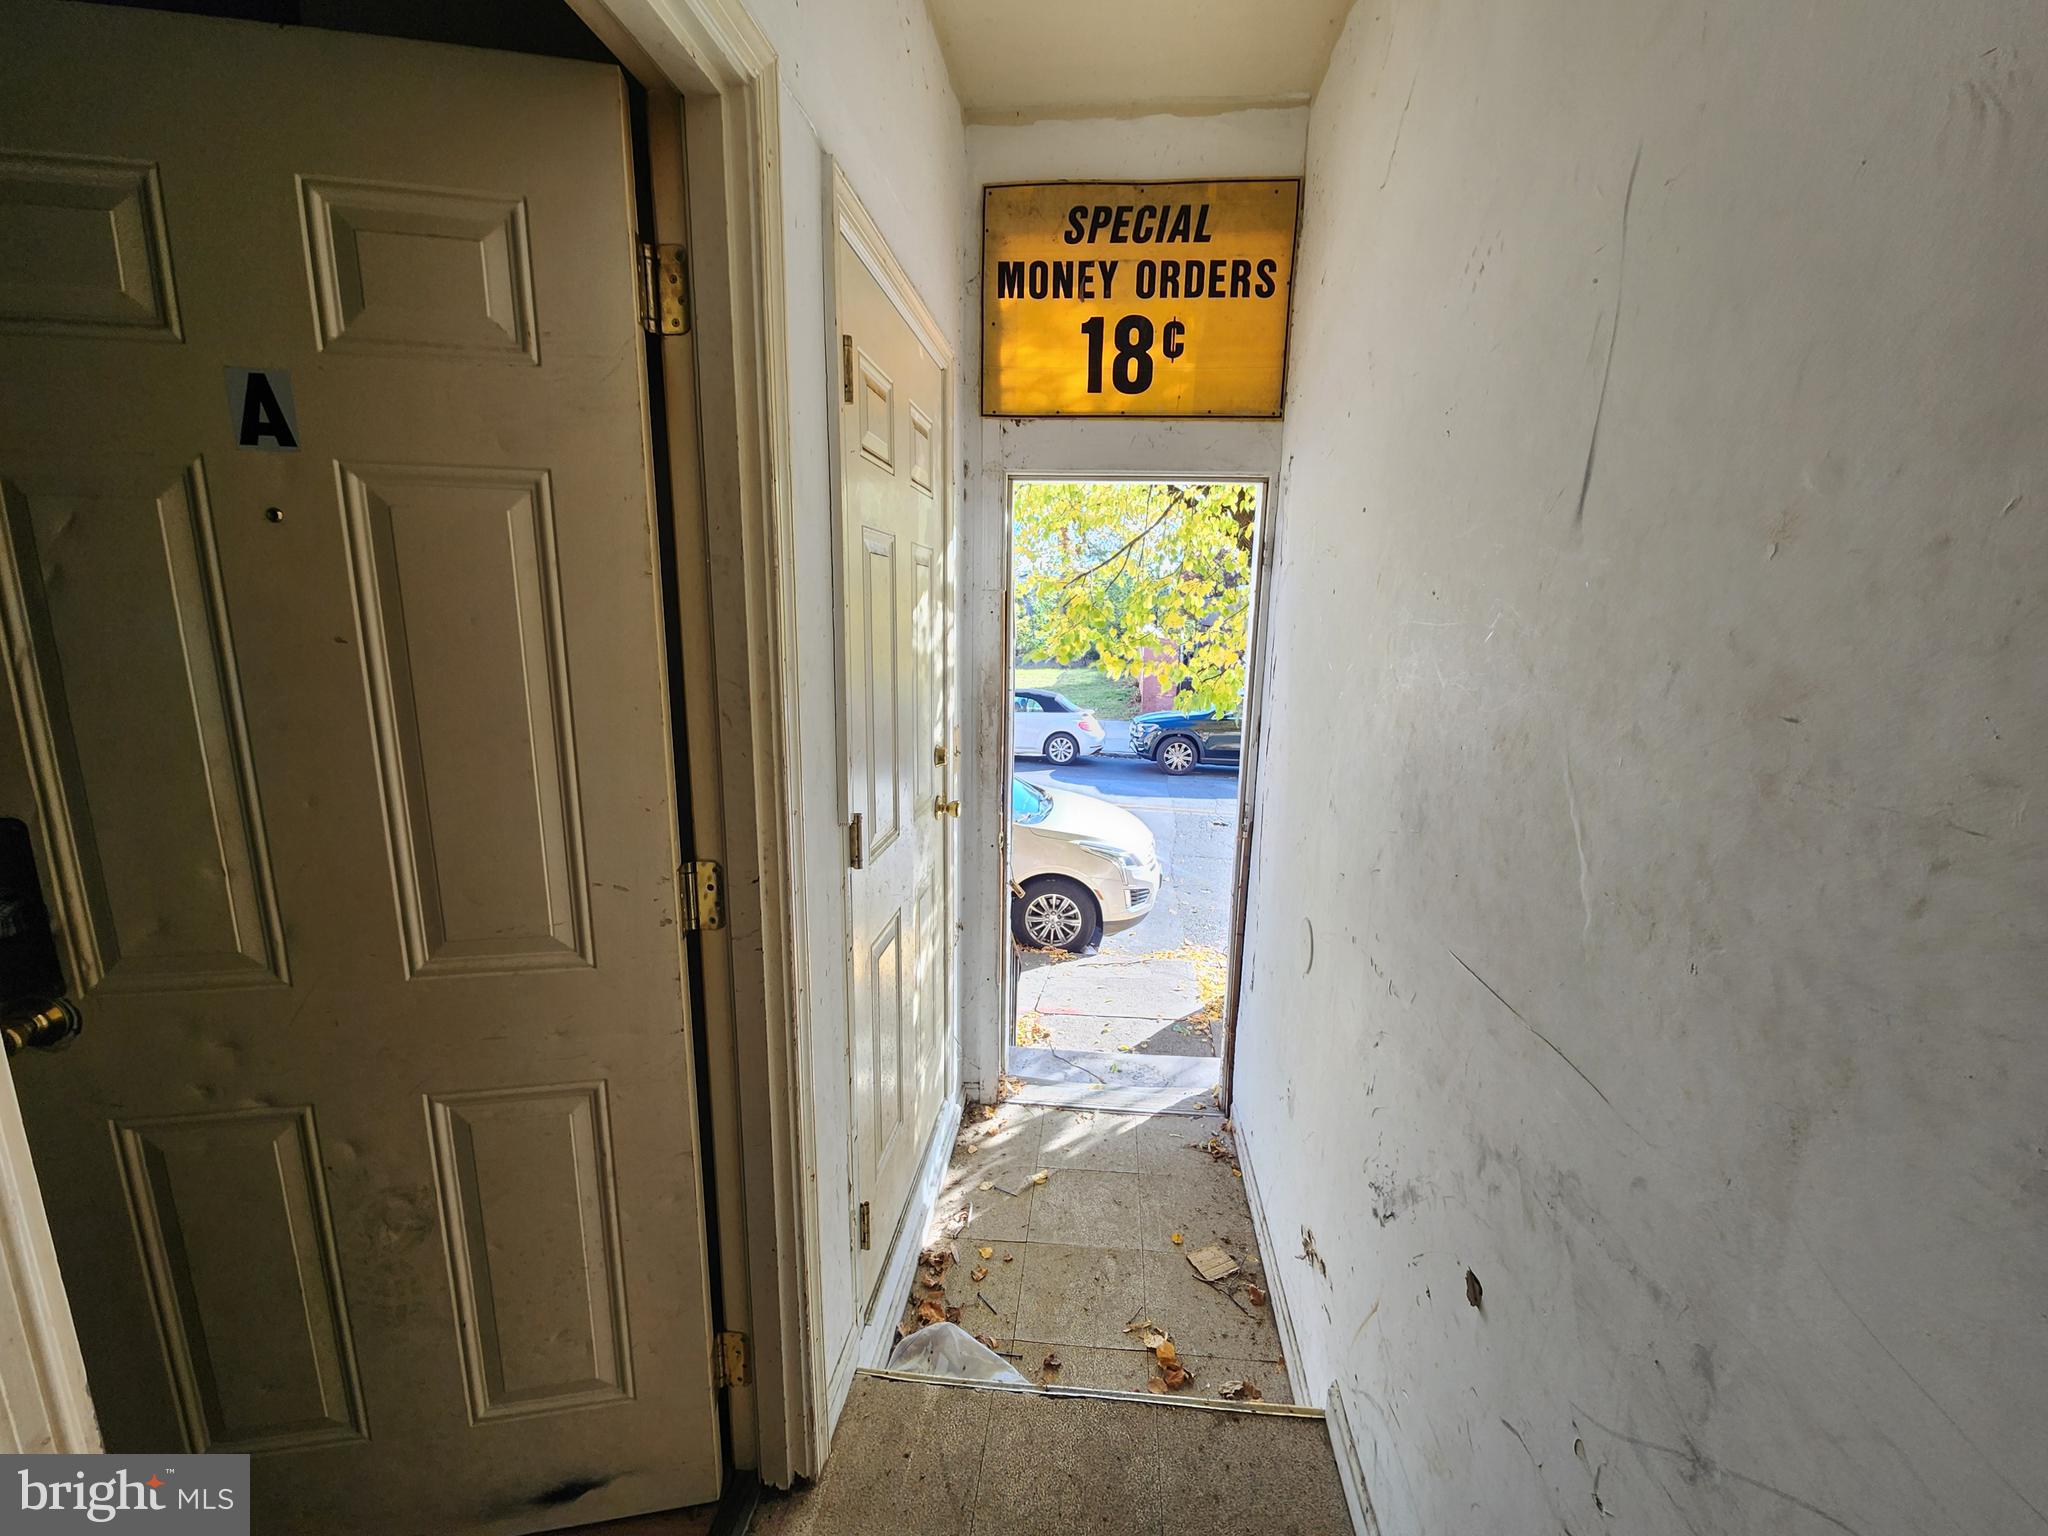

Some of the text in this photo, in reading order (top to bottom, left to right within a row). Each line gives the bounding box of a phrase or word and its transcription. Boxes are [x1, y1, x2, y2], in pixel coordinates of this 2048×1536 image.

[1064, 204, 1212, 244] SPECIAL
[997, 259, 1277, 299] MONEY ORDERS
[239, 372, 298, 447] A
